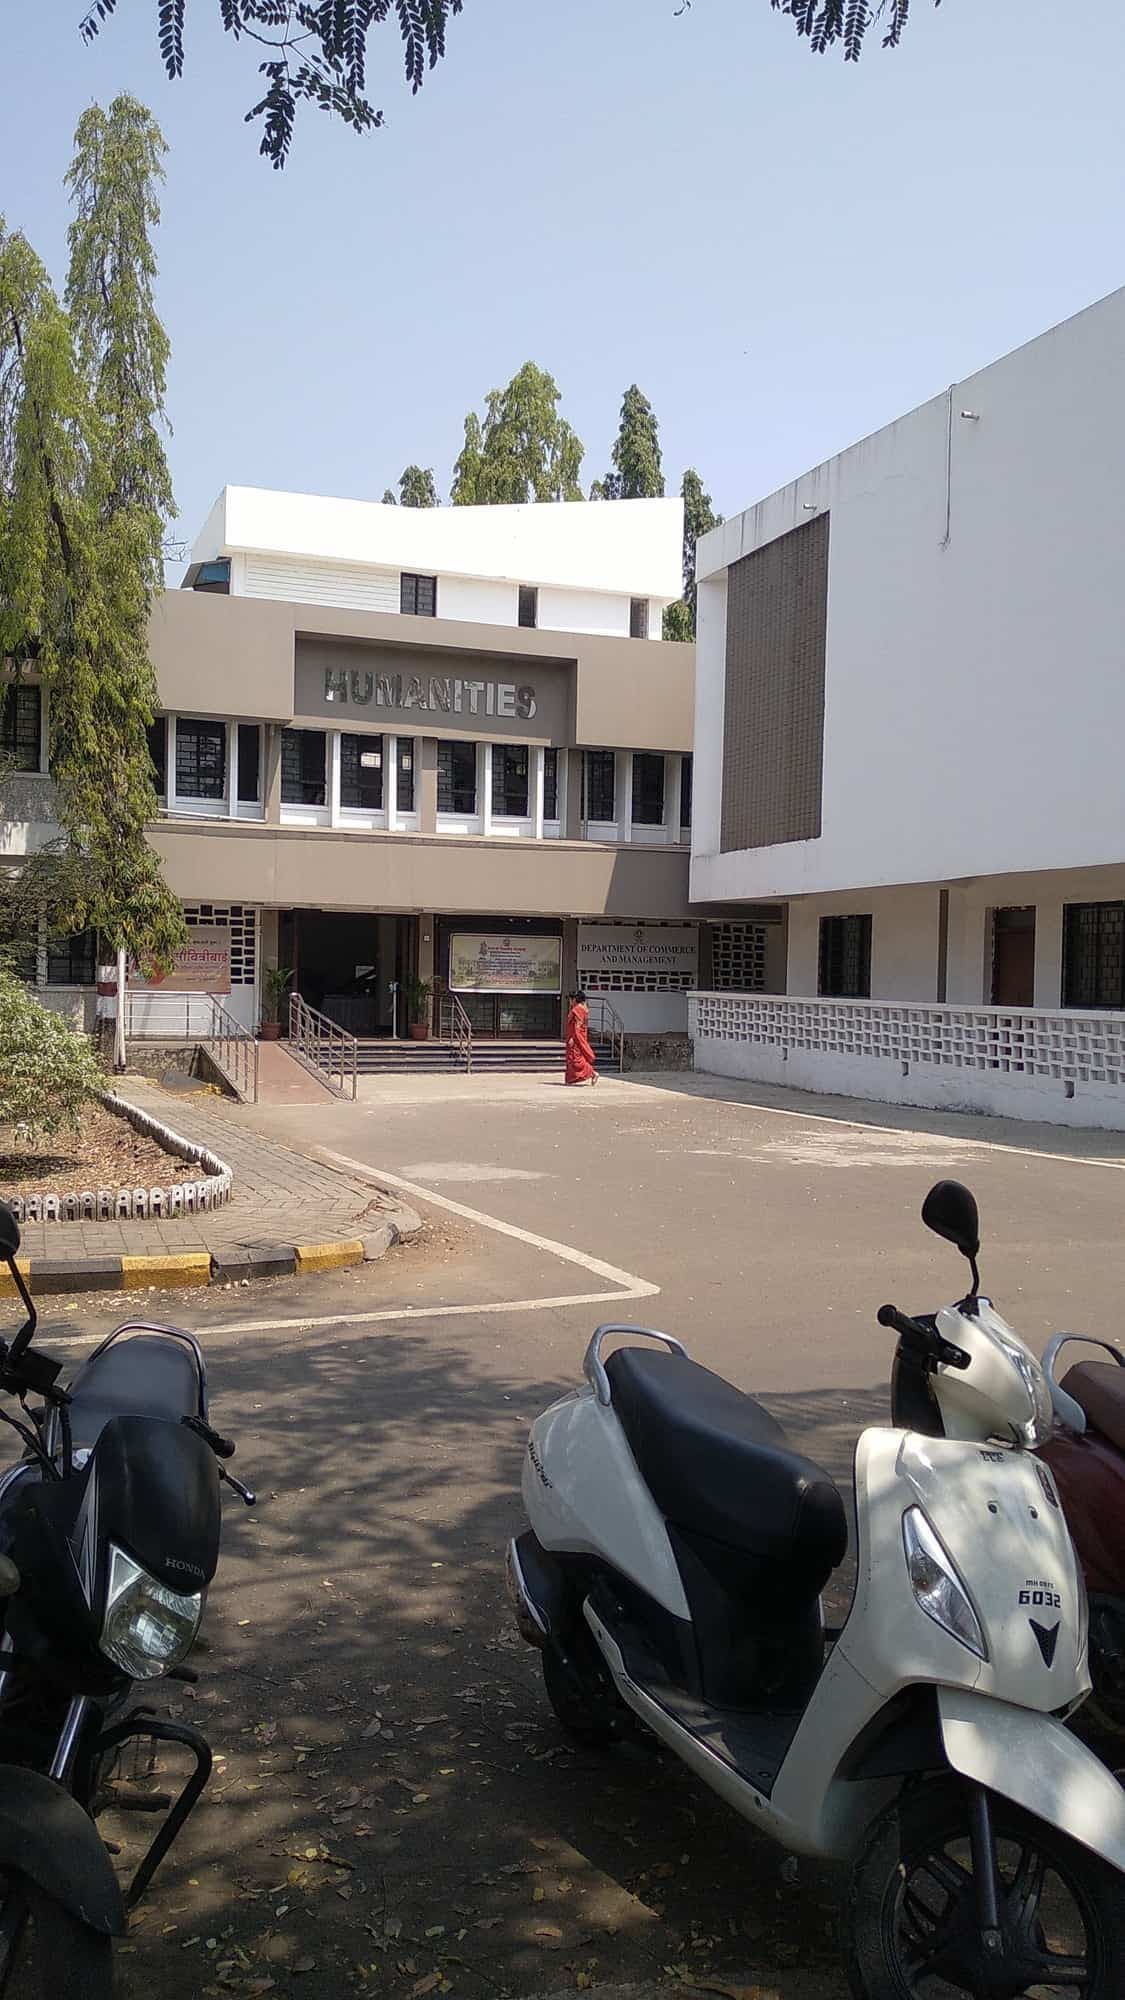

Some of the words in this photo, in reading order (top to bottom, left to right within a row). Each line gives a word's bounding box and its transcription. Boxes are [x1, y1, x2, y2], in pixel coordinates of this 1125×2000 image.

[324, 668, 537, 719] HUMANITIES
[580, 943, 635, 954] DEPARTMENT
[636, 944, 649, 954] OF
[649, 944, 697, 955] COMMERCE
[601, 954, 618, 964] AND
[620, 954, 677, 966] MANAGEMENT
[165, 1557, 206, 1581] HONDA
[1018, 1590, 1061, 1609] 6032
